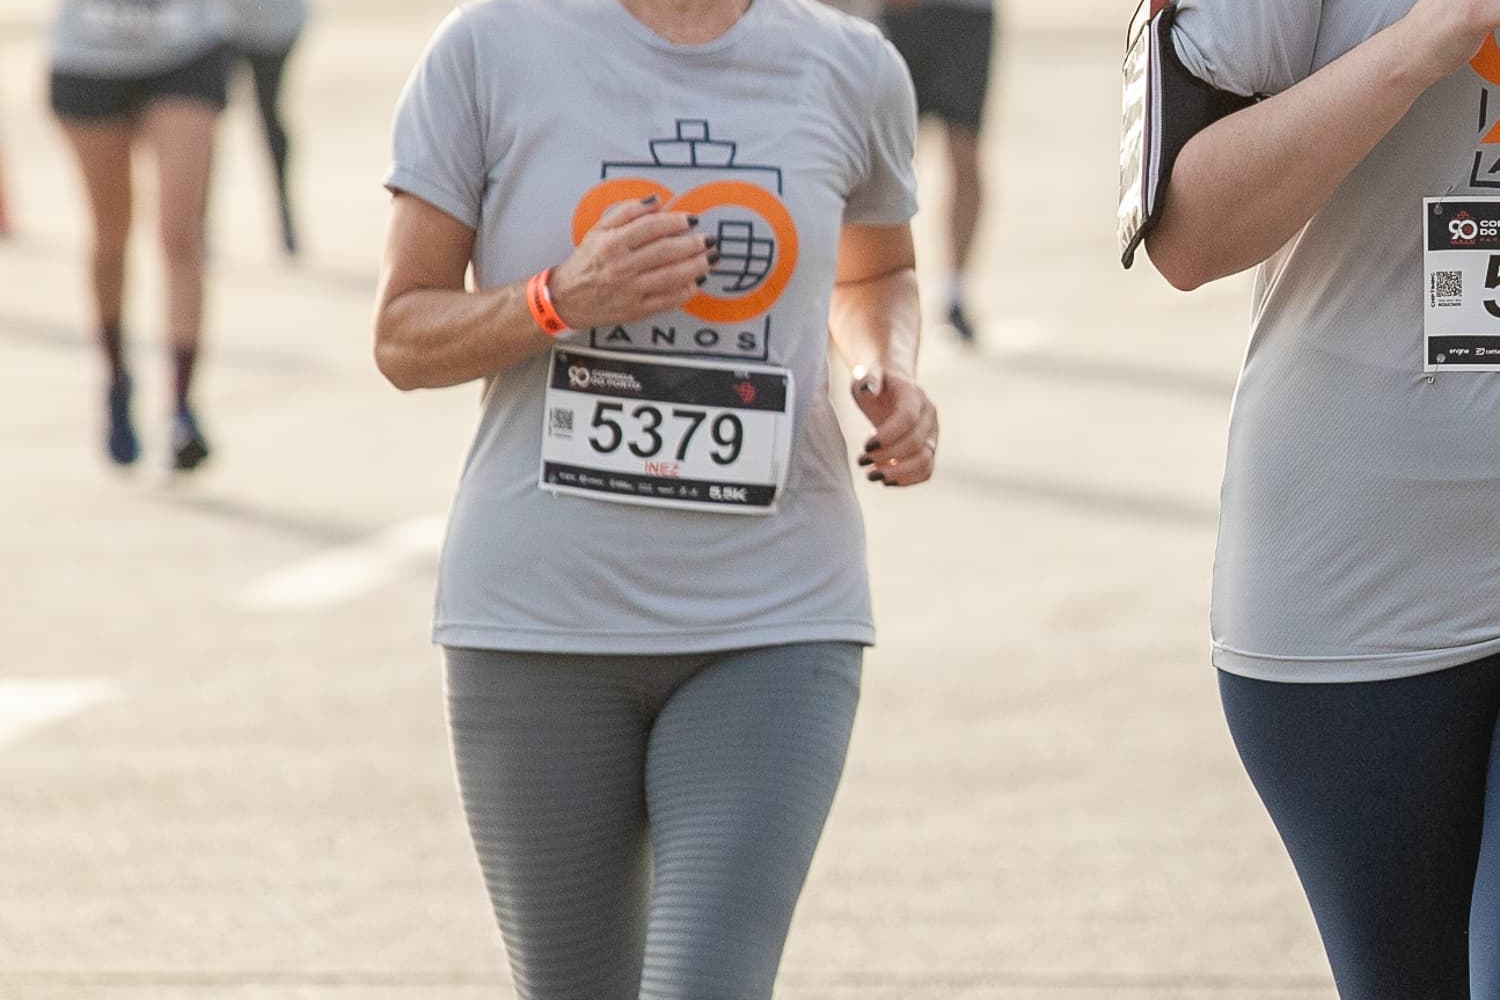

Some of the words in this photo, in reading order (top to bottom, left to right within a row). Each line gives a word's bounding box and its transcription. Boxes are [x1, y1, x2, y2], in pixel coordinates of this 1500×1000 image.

[1448, 219, 1478, 240] 90
[1479, 228, 1497, 236] DO
[605, 322, 757, 351] ANOS
[588, 401, 744, 466] 5379
